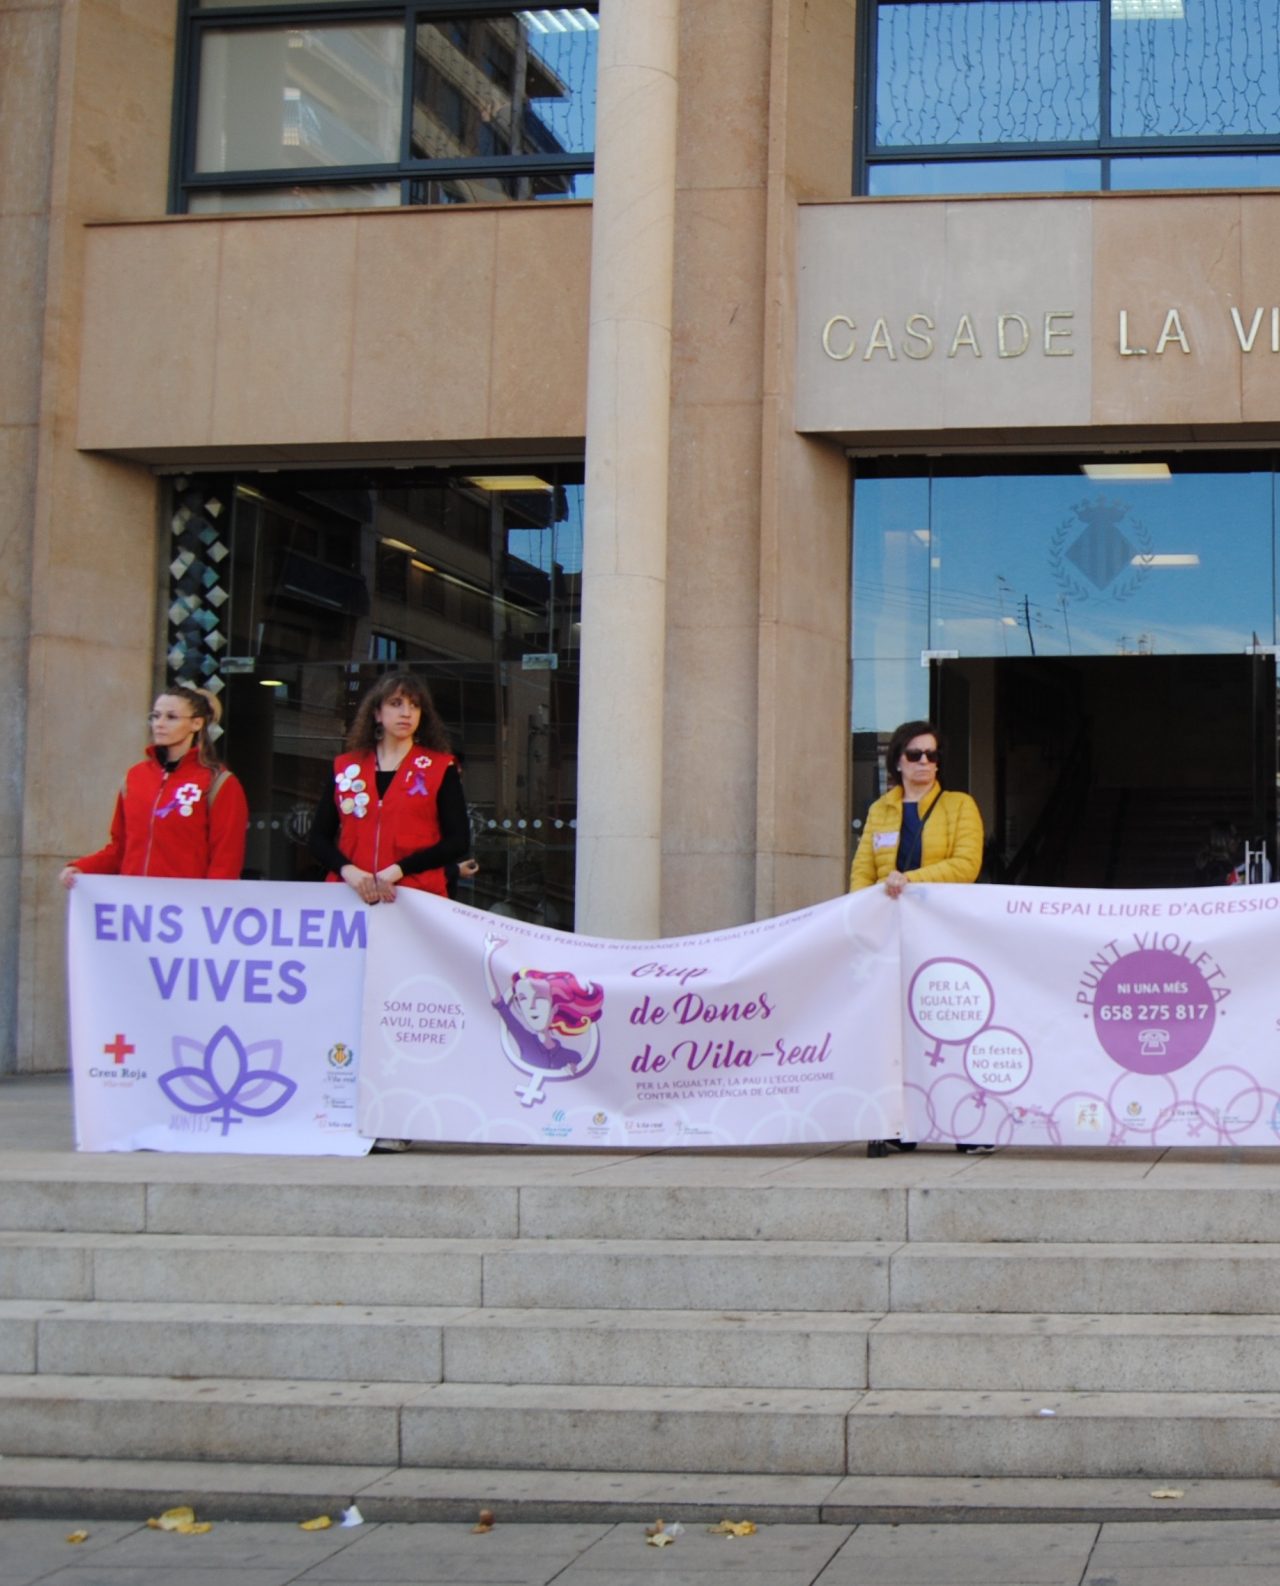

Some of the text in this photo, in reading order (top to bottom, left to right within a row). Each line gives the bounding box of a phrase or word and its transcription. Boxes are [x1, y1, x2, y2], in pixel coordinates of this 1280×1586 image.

[1118, 308, 1191, 356] LA
[1006, 900, 1032, 914] UN
[1039, 901, 1090, 915] ESPAI
[1097, 903, 1160, 917] LLIURE
[94, 903, 367, 949] ENS VOLEM
[631, 962, 709, 986] Grup
[1076, 931, 1231, 1006] PUNT VIOLETA
[148, 956, 308, 1005] VIVES
[929, 981, 970, 991] PER LA
[1117, 981, 1188, 994] NI UNA MÉS
[383, 1000, 465, 1016] SOM DONES,
[629, 991, 776, 1025] de Dones
[920, 995, 980, 1006] IGUALTAT
[919, 1010, 933, 1020] DE
[1100, 1004, 1208, 1021] 658 275 817
[380, 1016, 414, 1028] AVUI,
[395, 1031, 447, 1045] SEMPRE
[630, 1032, 832, 1074] de Vila-real
[972, 1046, 1023, 1055] En festes
[972, 1060, 989, 1069] NO
[89, 1067, 147, 1080] Creu Roja
[982, 1074, 1012, 1083] SOLA
[635, 1080, 653, 1091] PER
[656, 1080, 670, 1090] LA
[672, 1077, 726, 1090] IGUALTAT,
[728, 1076, 740, 1086] LA
[742, 1075, 762, 1086] PAU
[636, 1090, 679, 1101] CONTRA
[682, 1089, 694, 1099] LA
[750, 1087, 763, 1096] DE
